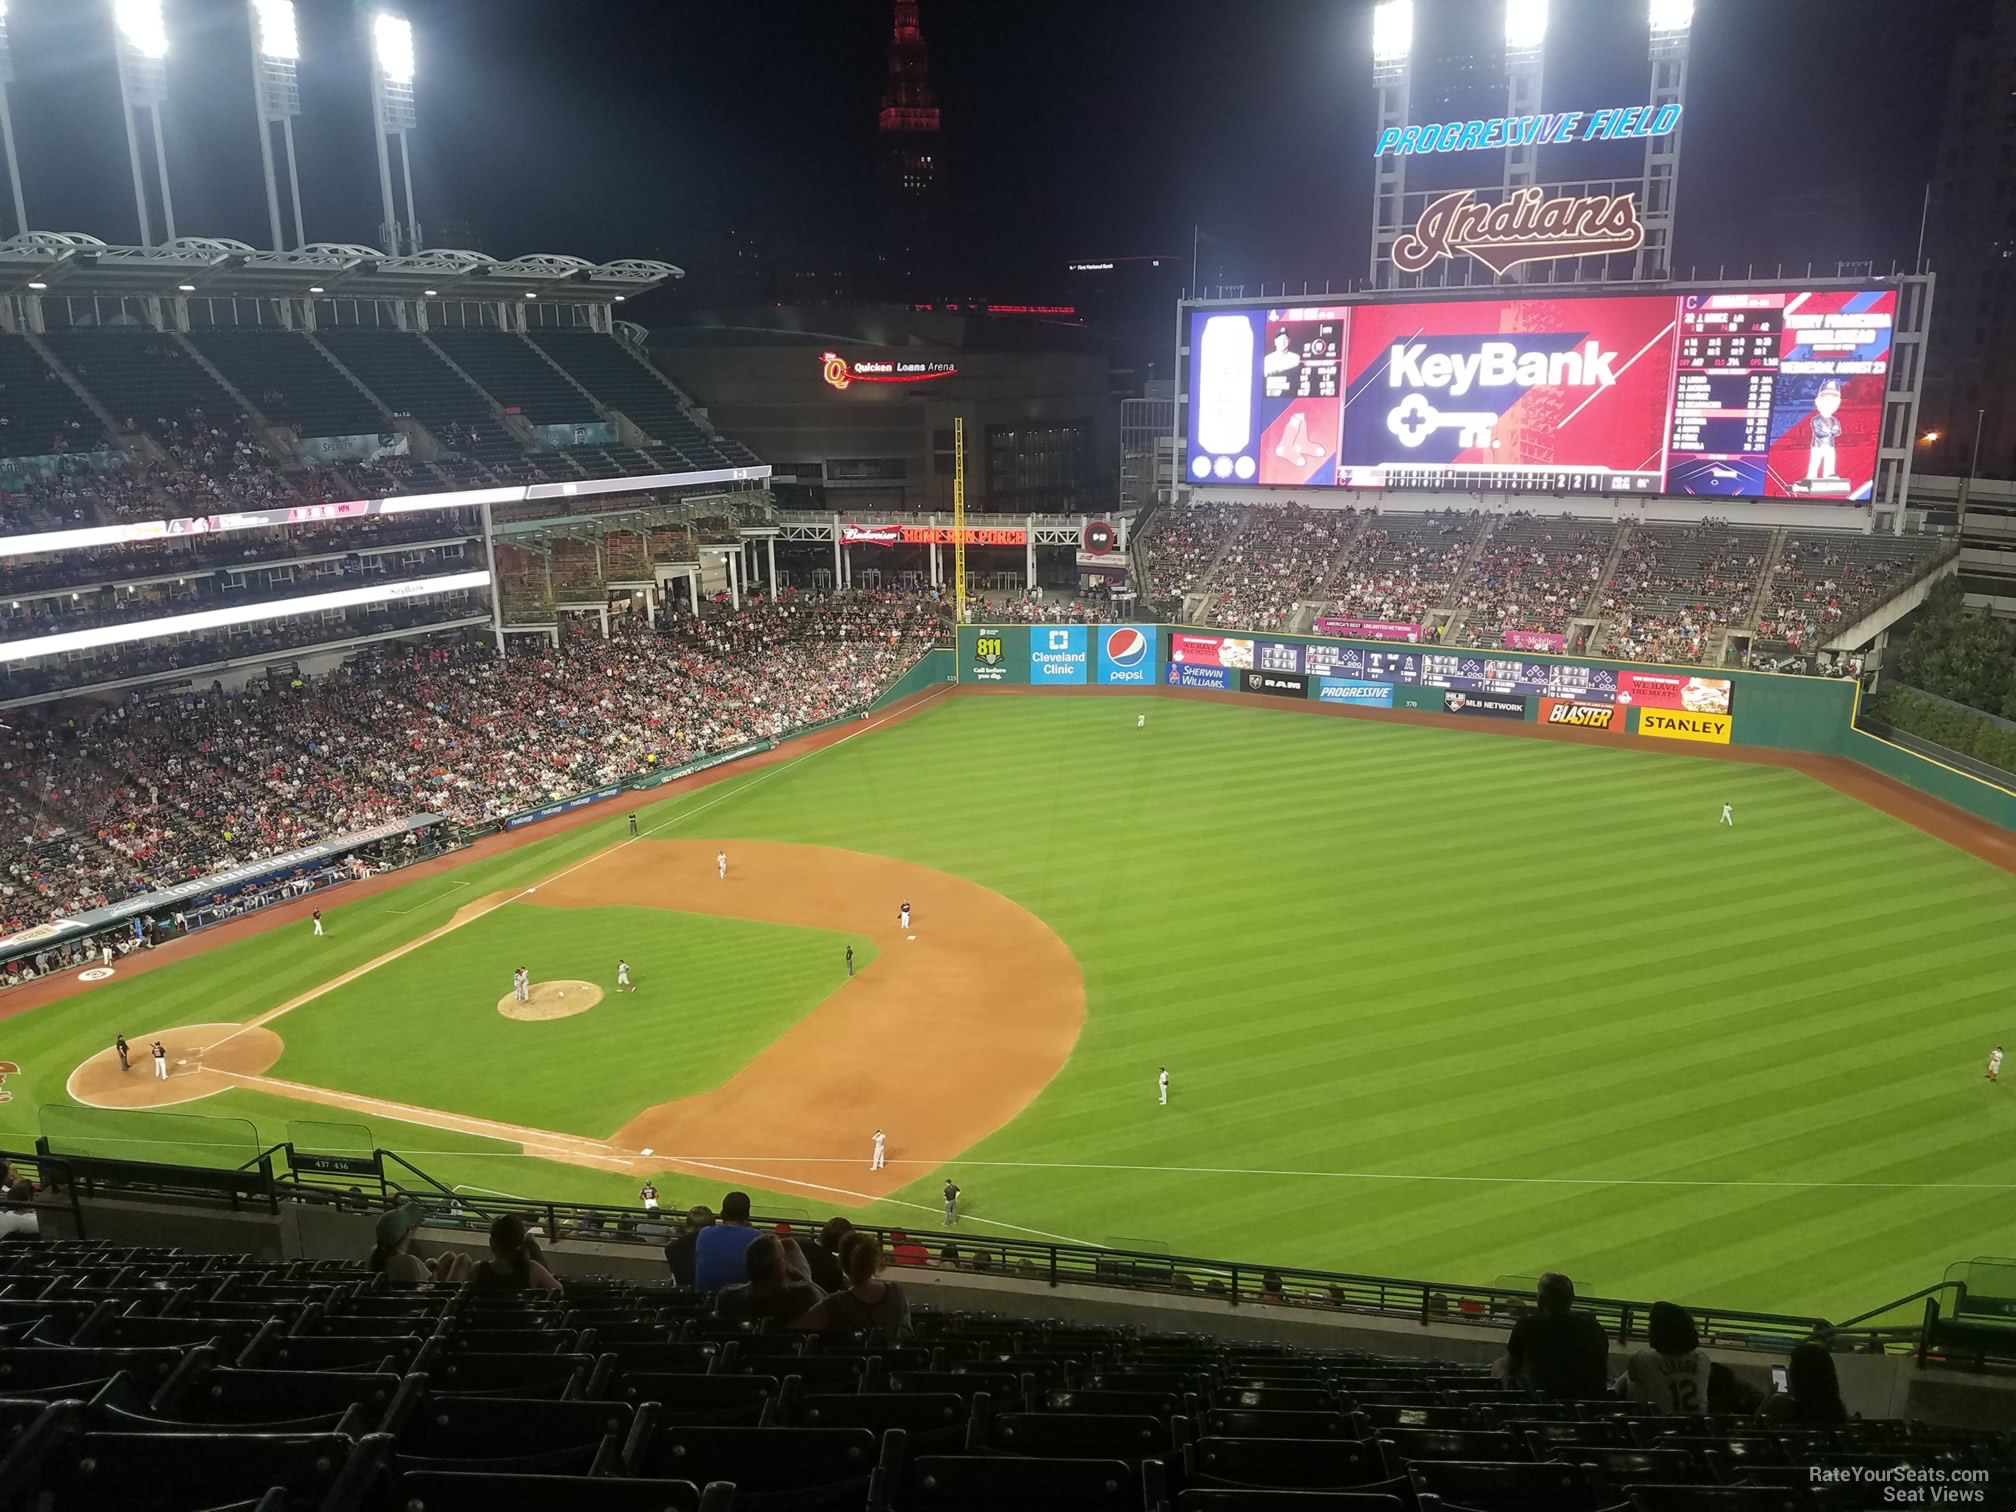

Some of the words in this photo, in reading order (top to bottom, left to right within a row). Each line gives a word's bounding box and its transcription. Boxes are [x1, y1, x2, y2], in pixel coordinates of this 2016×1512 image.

[1374, 111, 1583, 157] PROGRESSIVE
[1582, 103, 1683, 141] FIELD
[1392, 186, 1645, 275] Indians
[854, 362, 892, 373] Quicken
[897, 363, 926, 372] Loans
[928, 362, 955, 372] Arena
[1389, 340, 1618, 396] KeyBank
[322, 442, 353, 452] SPEAKER
[843, 528, 897, 540] Budweiser
[977, 638, 1001, 656] 811
[1032, 651, 1086, 663] Cleveland
[986, 666, 1006, 674] before
[1044, 664, 1074, 674] Clinic
[1184, 666, 1224, 678] SHERWIN
[1110, 670, 1143, 682] pepsi
[1265, 680, 1300, 689] RAM
[1651, 682, 1678, 692] HAVE
[1320, 687, 1390, 698] PROGRESSIVE
[1404, 700, 1418, 708] 370
[1466, 700, 1482, 708] MLB
[1484, 700, 1524, 712] NETWORK
[1549, 703, 1613, 728] BLASTER
[1645, 716, 1726, 735] STANLEY
[212, 846, 329, 883] ESTABLISHED
[315, 1160, 330, 1168] 437
[334, 1162, 348, 1170] 436
[1669, 1378, 1699, 1412] 12
